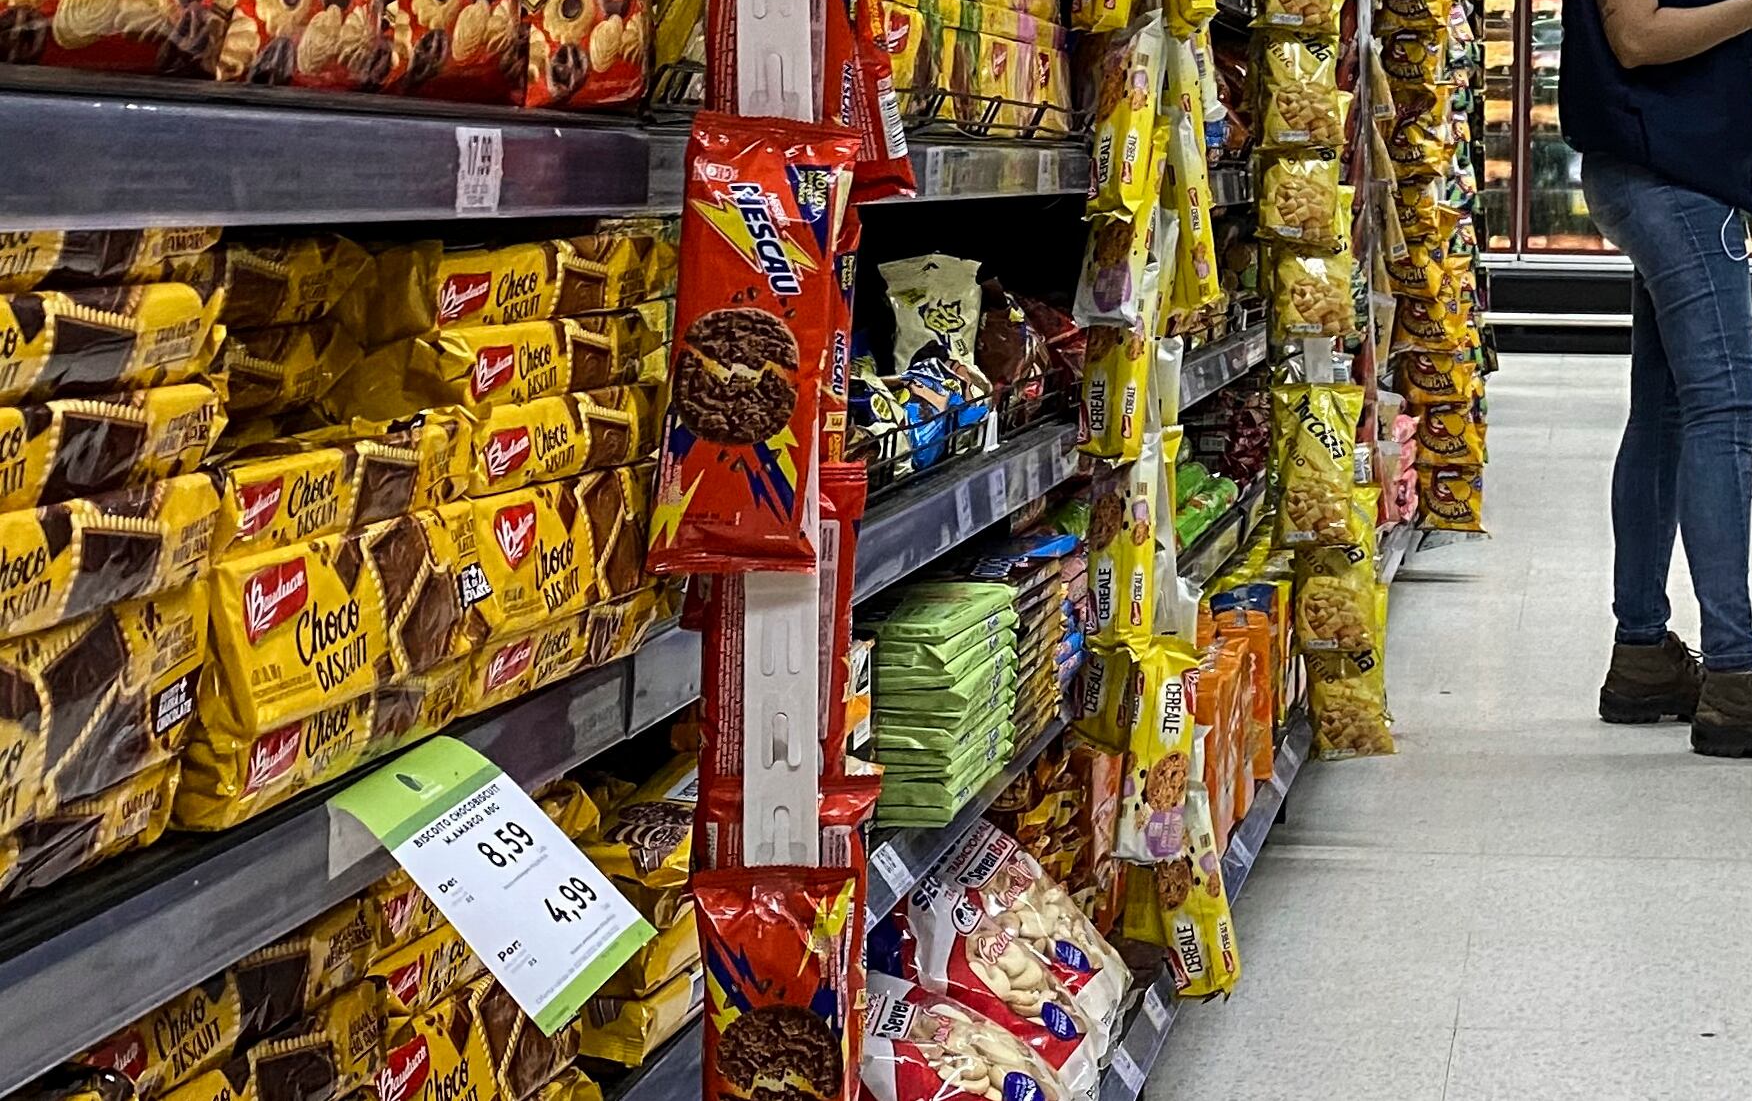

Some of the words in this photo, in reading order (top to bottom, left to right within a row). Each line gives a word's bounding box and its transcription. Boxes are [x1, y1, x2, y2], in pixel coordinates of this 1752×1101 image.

[728, 182, 803, 296] NESCAU
[496, 269, 539, 308] Choco
[518, 343, 551, 381] Choco
[1091, 380, 1106, 431] CEREALE
[534, 421, 568, 460] Choco
[287, 470, 336, 518] Choco
[534, 537, 575, 591] Choco
[1099, 567, 1112, 620] CEREALE
[296, 599, 360, 667] Choco
[316, 631, 368, 694] BISCUIT
[306, 707, 350, 759] Choco
[1163, 682, 1182, 735] CEREALE
[413, 817, 452, 849] BISCOITO
[450, 783, 501, 821] CHOCOBISCUIT
[438, 876, 459, 894] De:
[477, 821, 535, 868] 8,59
[497, 938, 522, 962] Por:
[543, 875, 598, 925] 4,99
[1181, 924, 1203, 974] CEREALE
[152, 994, 207, 1062] Choco
